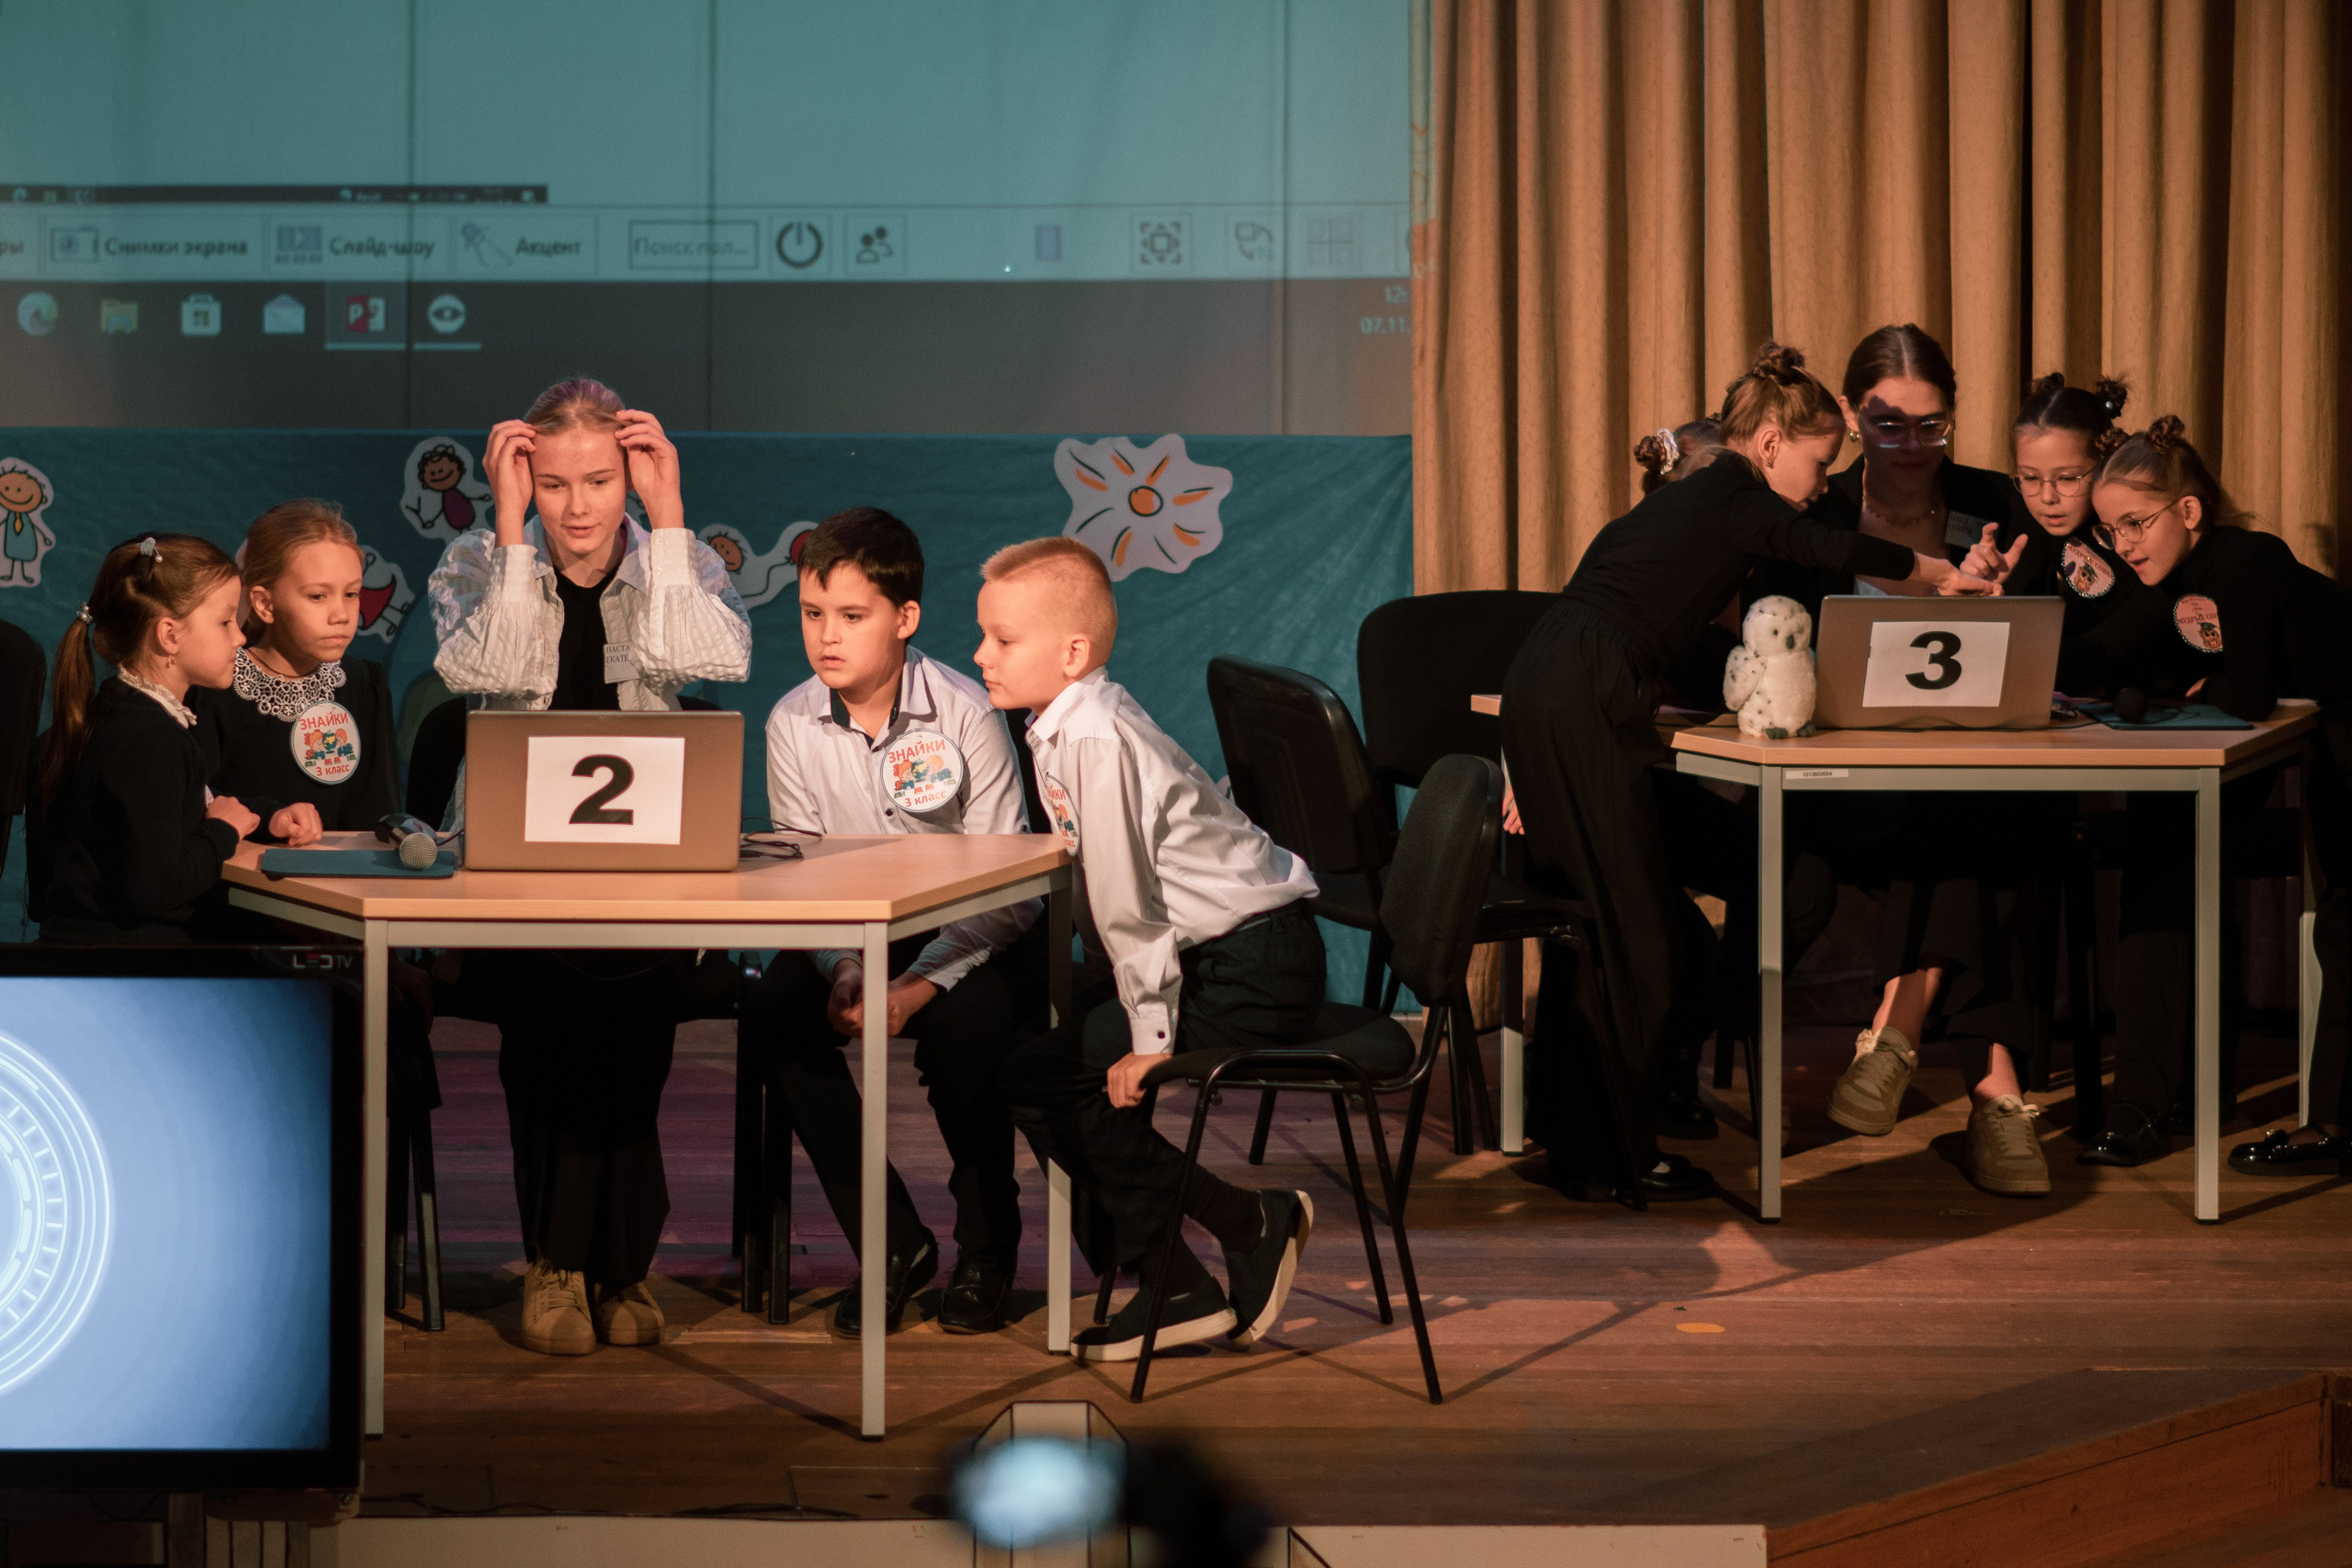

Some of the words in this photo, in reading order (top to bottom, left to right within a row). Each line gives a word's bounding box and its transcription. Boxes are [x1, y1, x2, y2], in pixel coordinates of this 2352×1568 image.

[105, 237, 179, 255] Снимки
[185, 241, 248, 260] экрана
[329, 236, 435, 260] Слайд-шоу
[515, 237, 581, 258] Акцент
[606, 644, 630, 653] НАСТА
[606, 654, 629, 663] ЕКАТЕ
[1905, 630, 1962, 690] 3
[299, 711, 349, 730] ЗНАЙКИ
[888, 739, 945, 762] ЗНАЙКИ
[315, 766, 322, 776] 3
[325, 764, 350, 775] класс
[569, 753, 635, 826] 2
[904, 797, 912, 807] 3
[914, 790, 947, 806] класс
